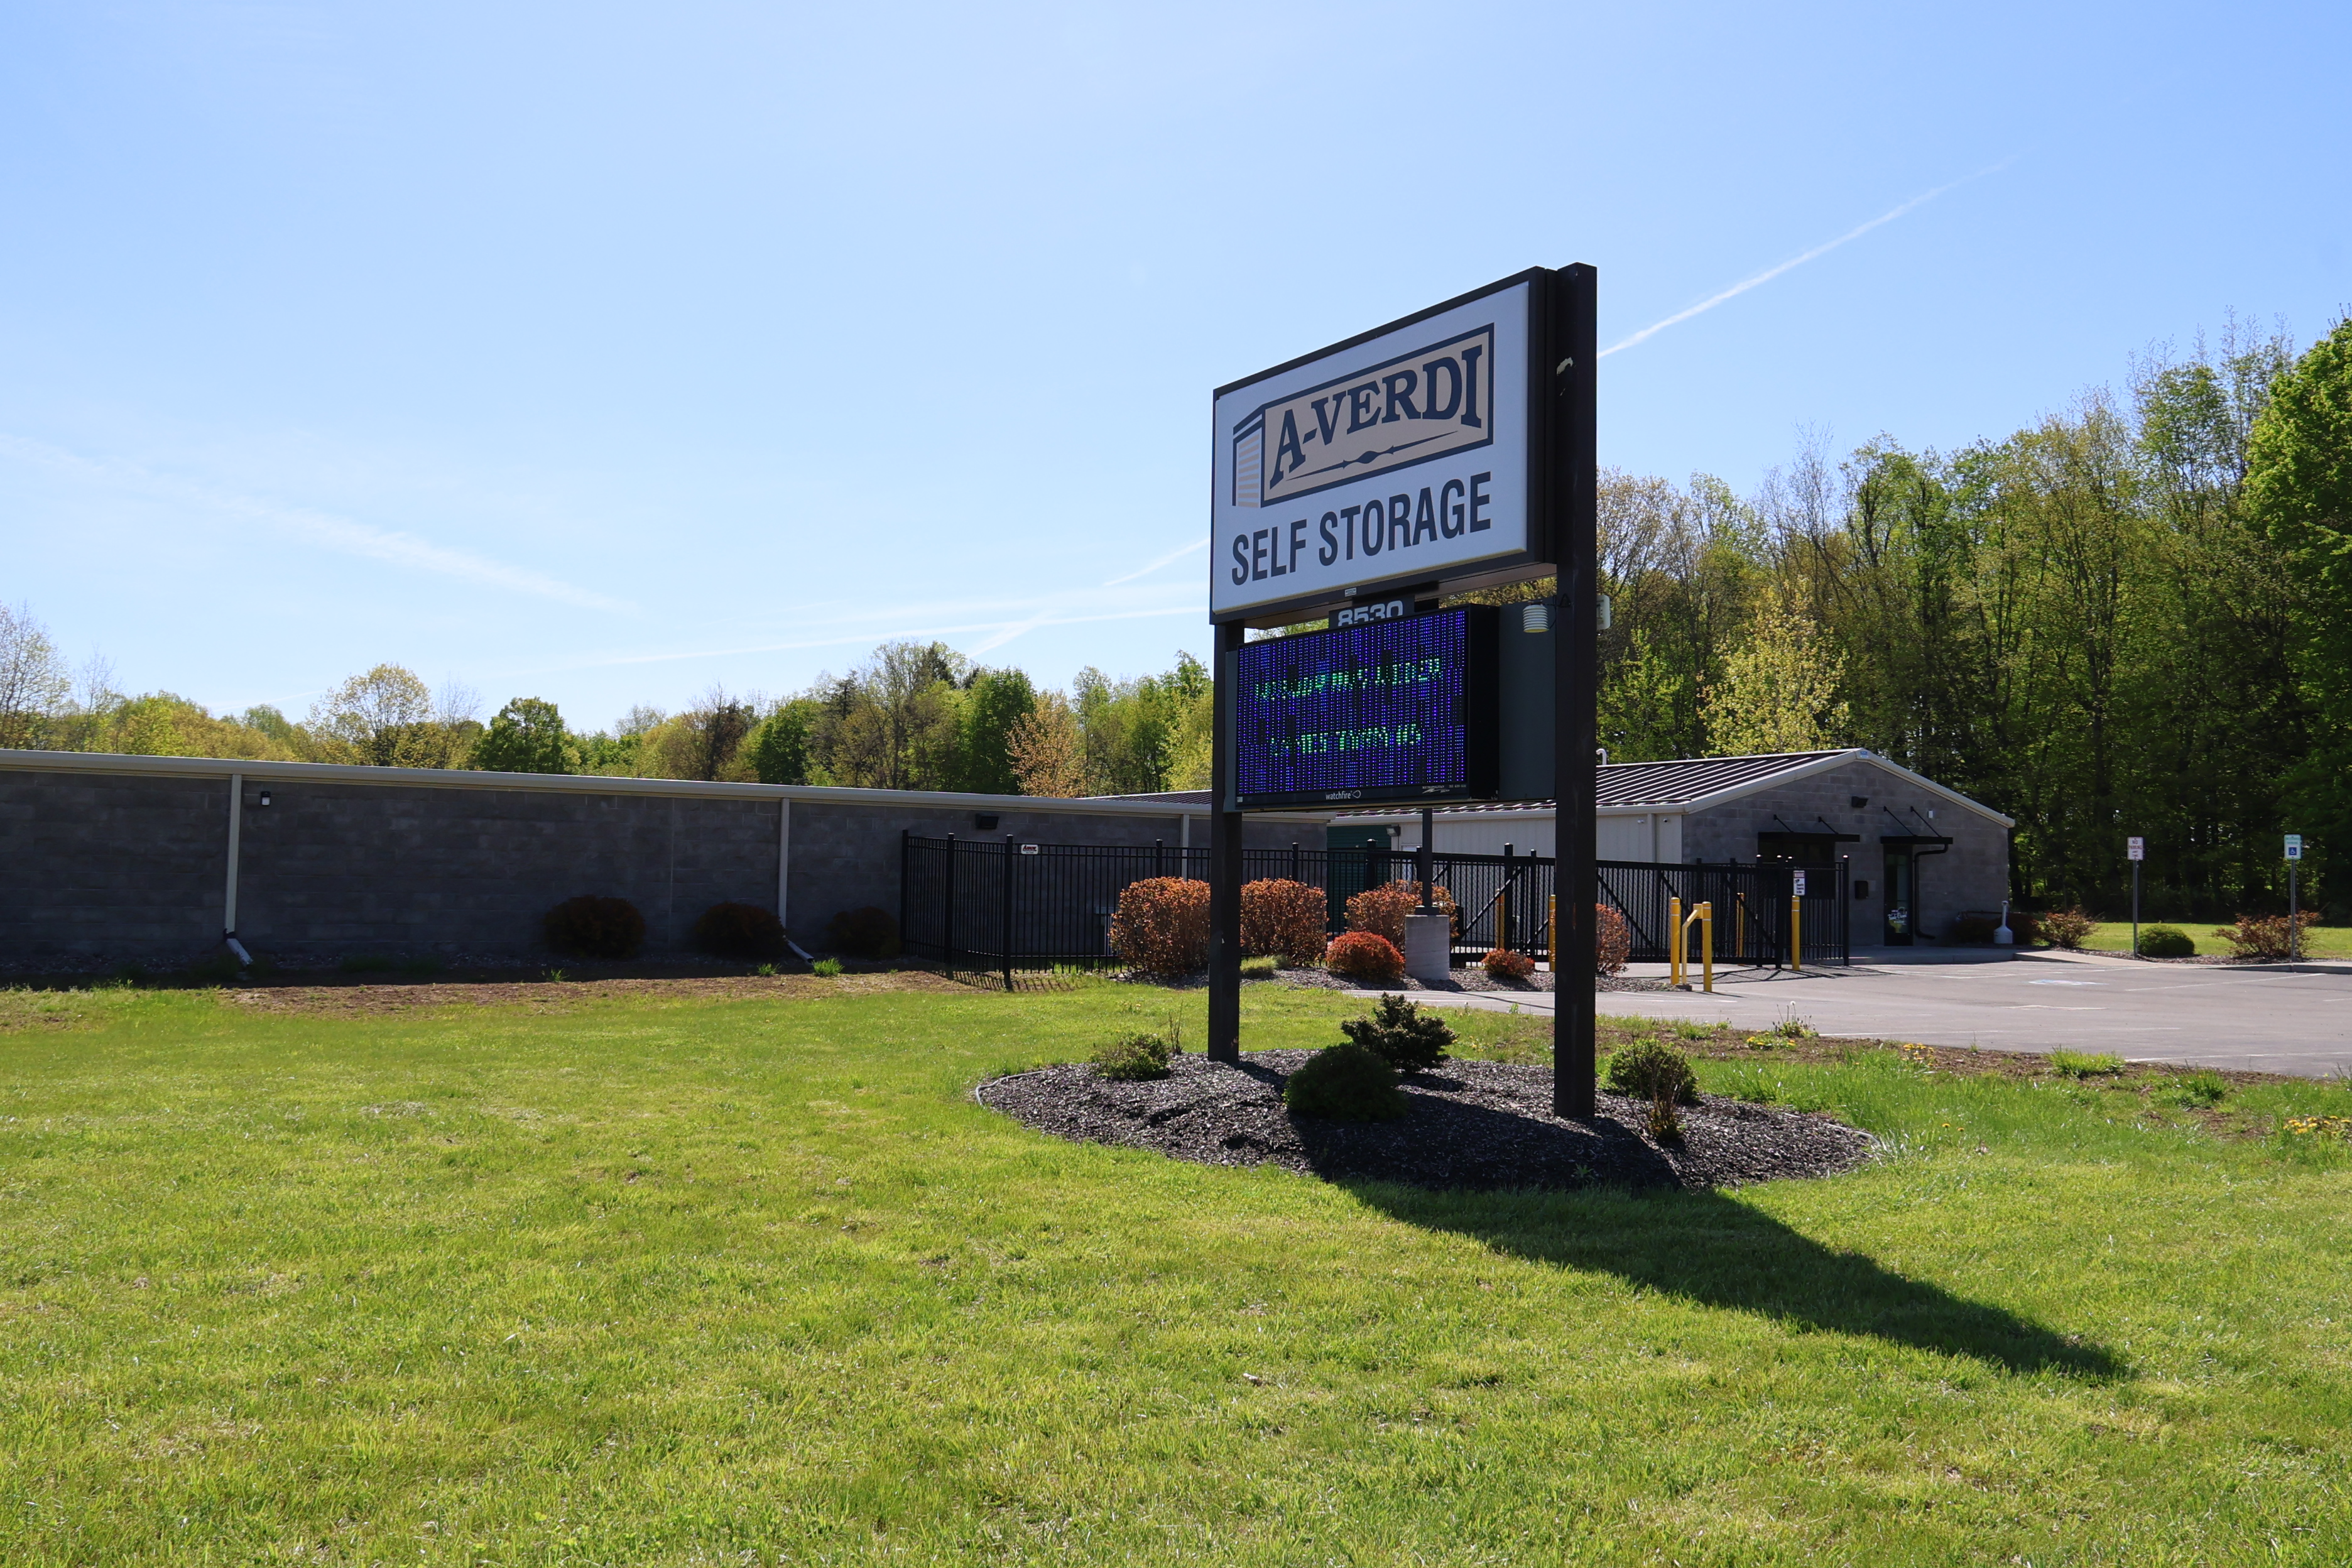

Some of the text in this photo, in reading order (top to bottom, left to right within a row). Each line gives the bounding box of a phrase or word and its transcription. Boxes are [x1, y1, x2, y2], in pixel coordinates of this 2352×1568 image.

[1269, 344, 1483, 490] A-VERDI
[1232, 471, 1491, 585] SELF STORAGE
[1338, 600, 1403, 627] 8530
[1326, 790, 1351, 800] watchfire
